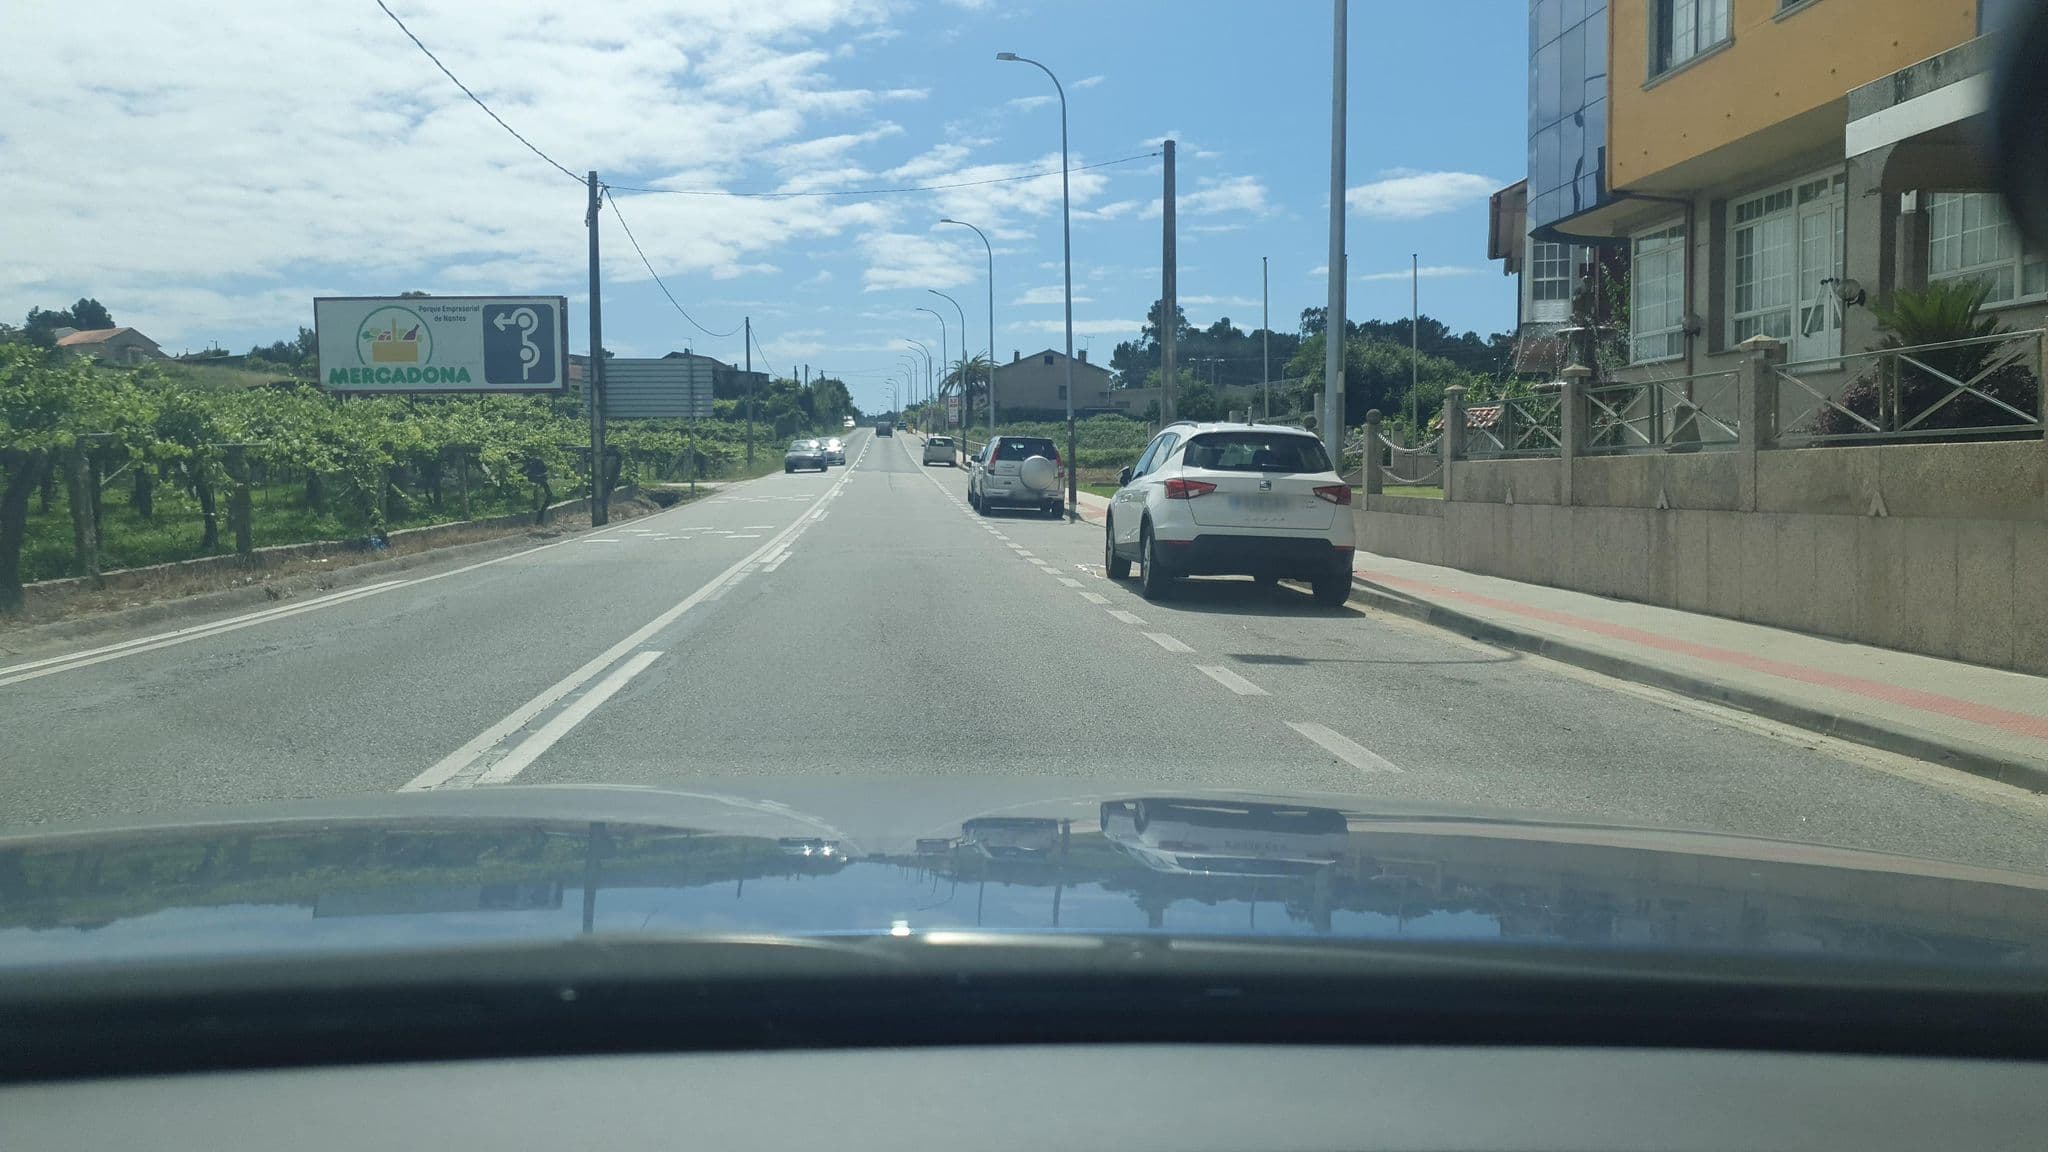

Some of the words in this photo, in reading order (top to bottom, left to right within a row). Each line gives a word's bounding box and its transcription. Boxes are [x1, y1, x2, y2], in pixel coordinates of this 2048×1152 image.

[418, 305, 441, 313] Parque
[442, 305, 480, 313] Empresarial
[328, 366, 472, 385] MERCADONA
